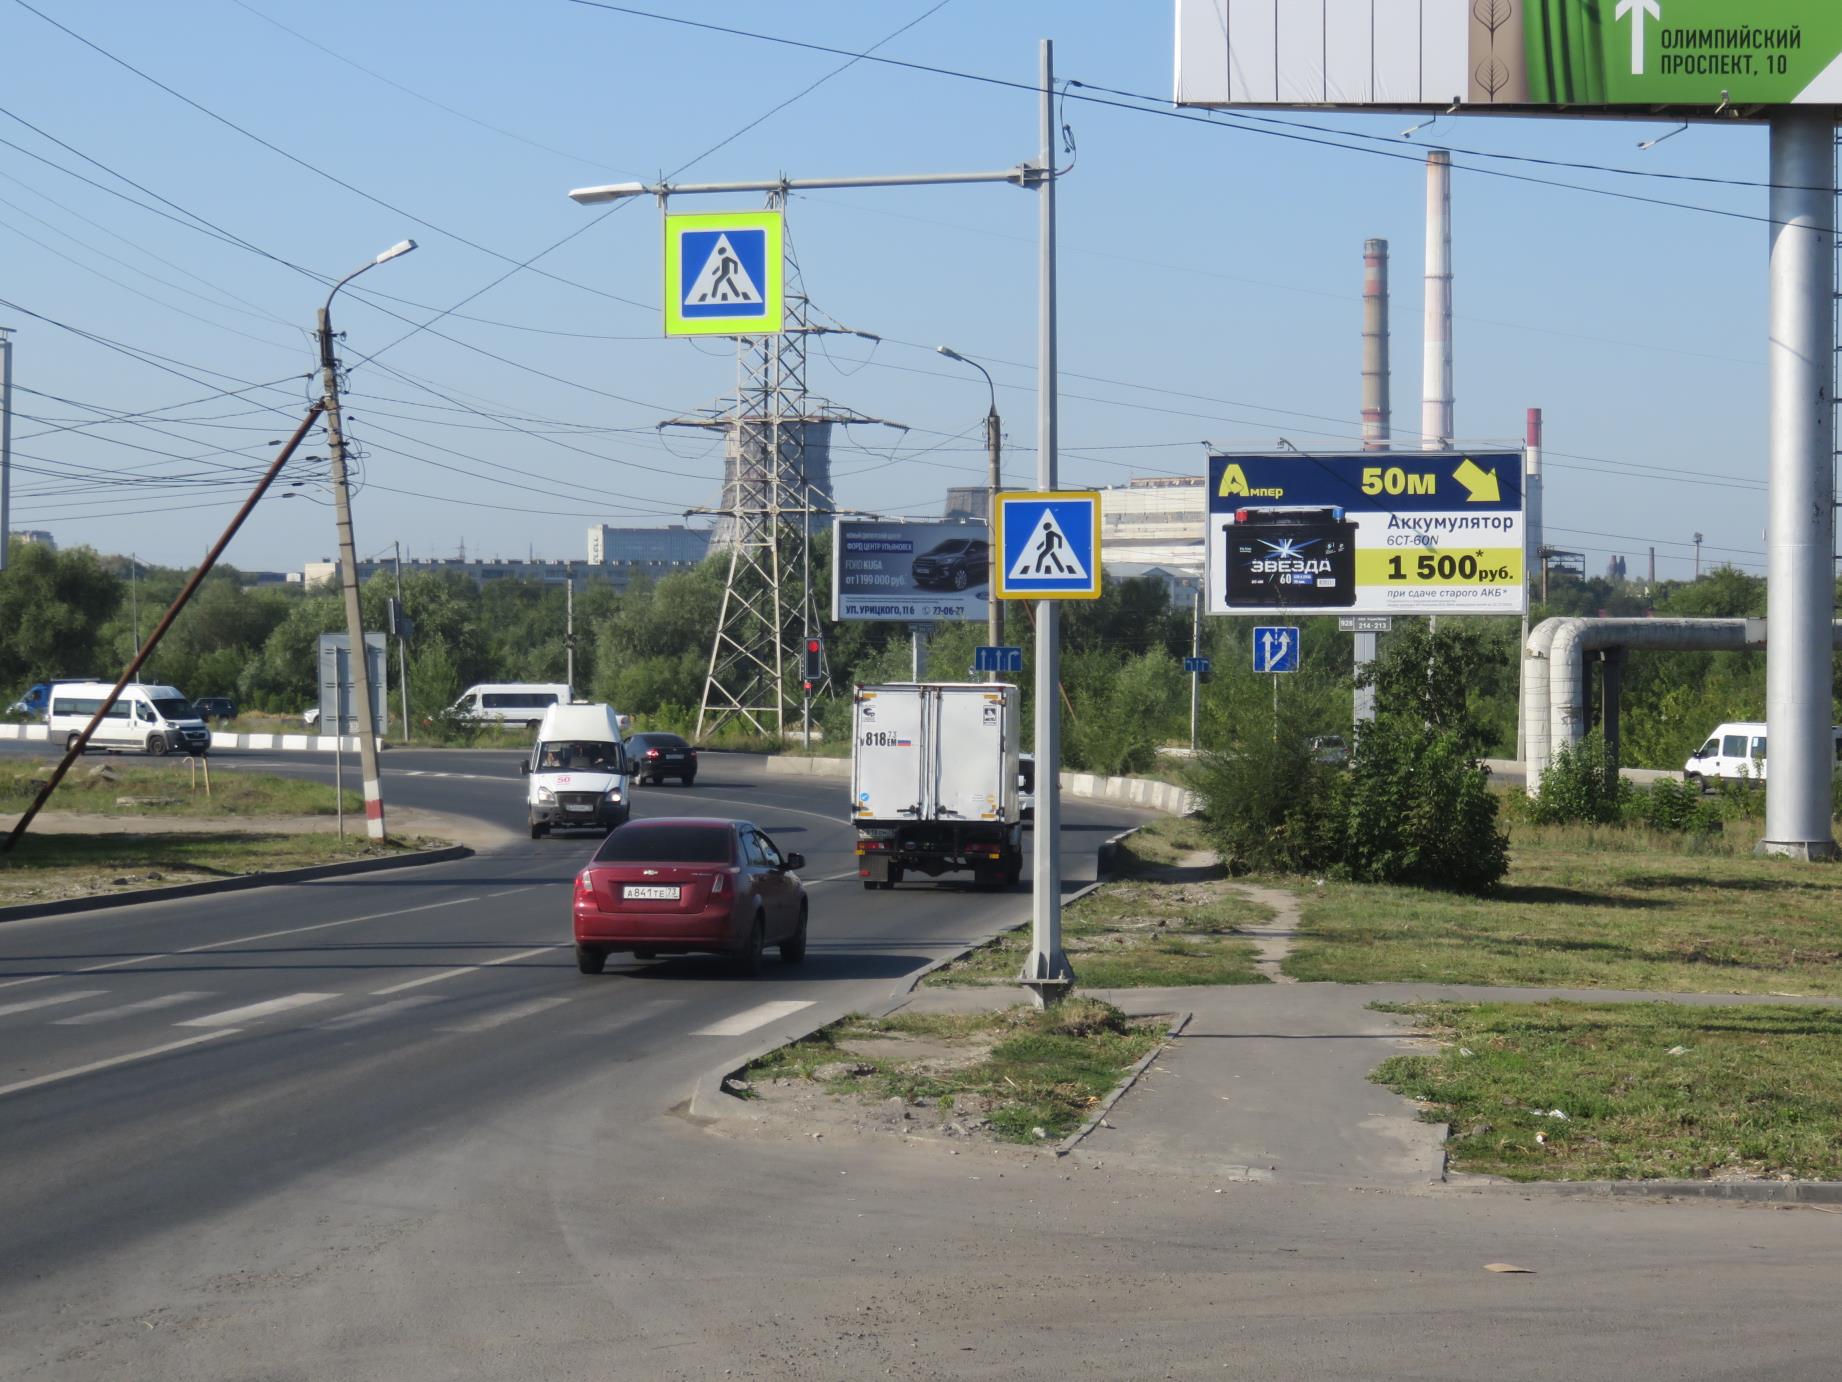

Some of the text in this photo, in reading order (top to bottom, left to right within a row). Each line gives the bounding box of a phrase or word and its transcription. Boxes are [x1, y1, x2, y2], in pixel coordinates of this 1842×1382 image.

[1661, 25, 1801, 49] ОЛИМПИЙСКИЙ
[1661, 54, 1787, 76] ПРОСПЕКТ, 10
[1218, 463, 1284, 499] Ампер
[1362, 467, 1436, 495] 50м
[1387, 514, 1514, 533] Аккумулятор
[1250, 559, 1332, 574] ЗВЕЗДА
[1388, 555, 1407, 580] 1
[1478, 566, 1514, 582] руб.
[1280, 573, 1291, 584] 60
[1387, 590, 1406, 600] при
[1408, 590, 1437, 600] сдаче
[1439, 590, 1478, 600] старого
